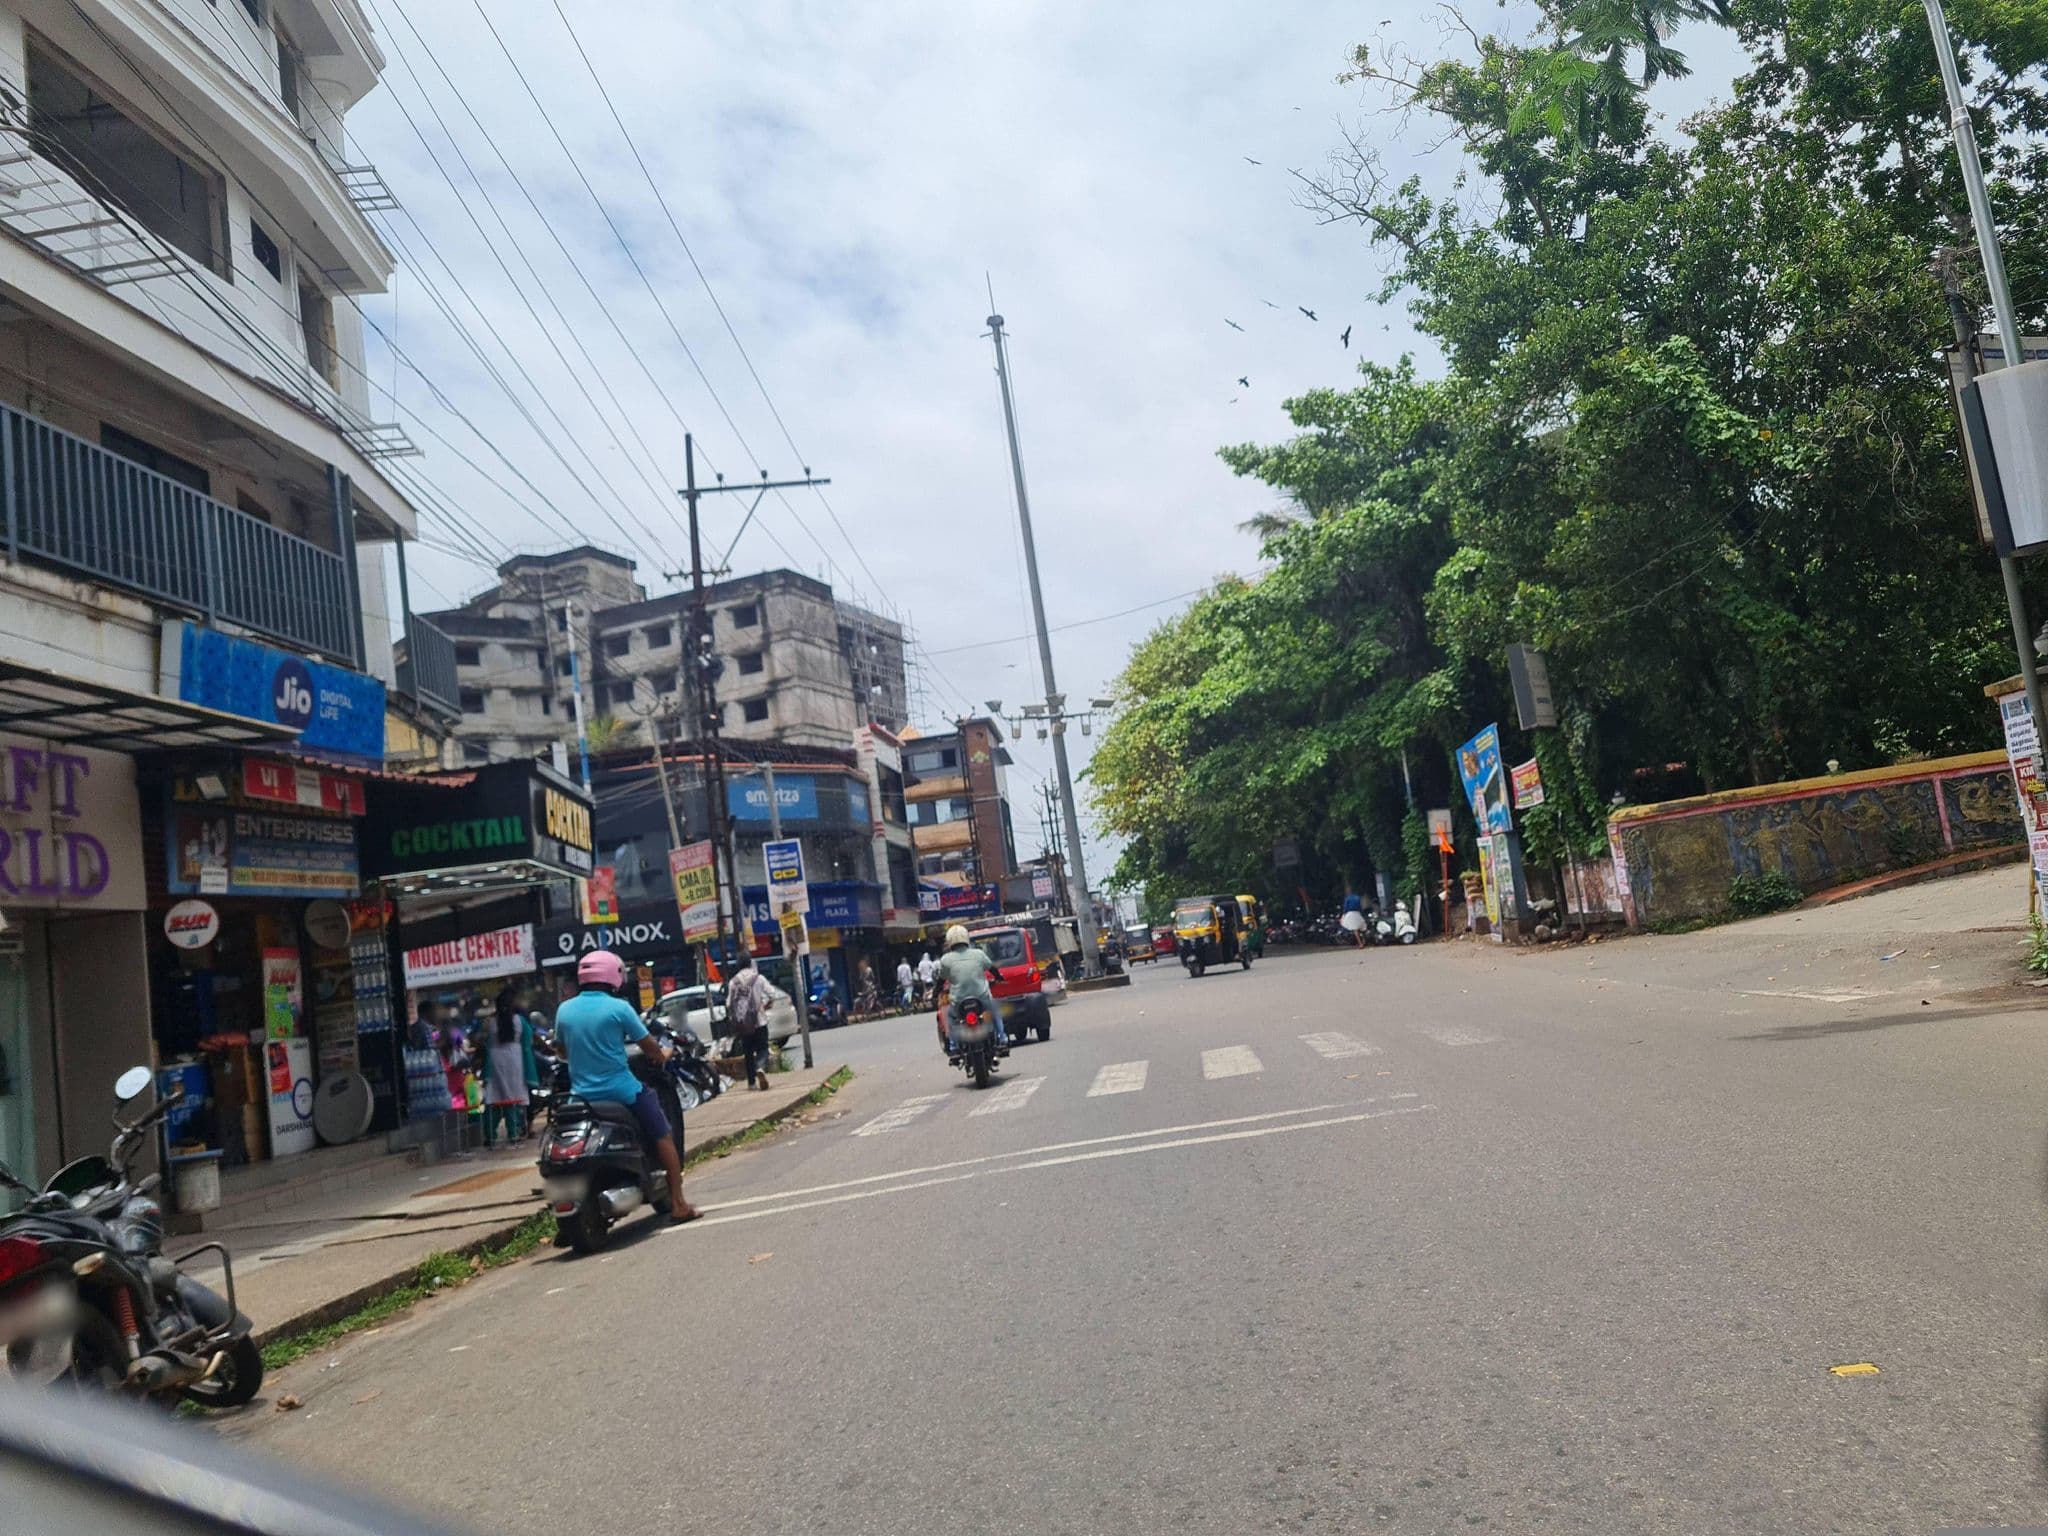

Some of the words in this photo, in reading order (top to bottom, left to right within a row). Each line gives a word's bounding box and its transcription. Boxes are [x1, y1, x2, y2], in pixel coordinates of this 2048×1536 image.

[276, 676, 312, 715] Jio
[320, 689, 353, 710] DIGITAL
[0, 746, 90, 817] FT
[745, 787, 800, 803] smrtza
[234, 813, 354, 843] ENTERPRISES
[391, 816, 527, 858] COCKTAIL
[545, 787, 592, 851] COCKTAIL
[824, 906, 850, 917] PLAZA
[407, 941, 464, 970] MOBILE
[464, 929, 521, 961] CENTRE
